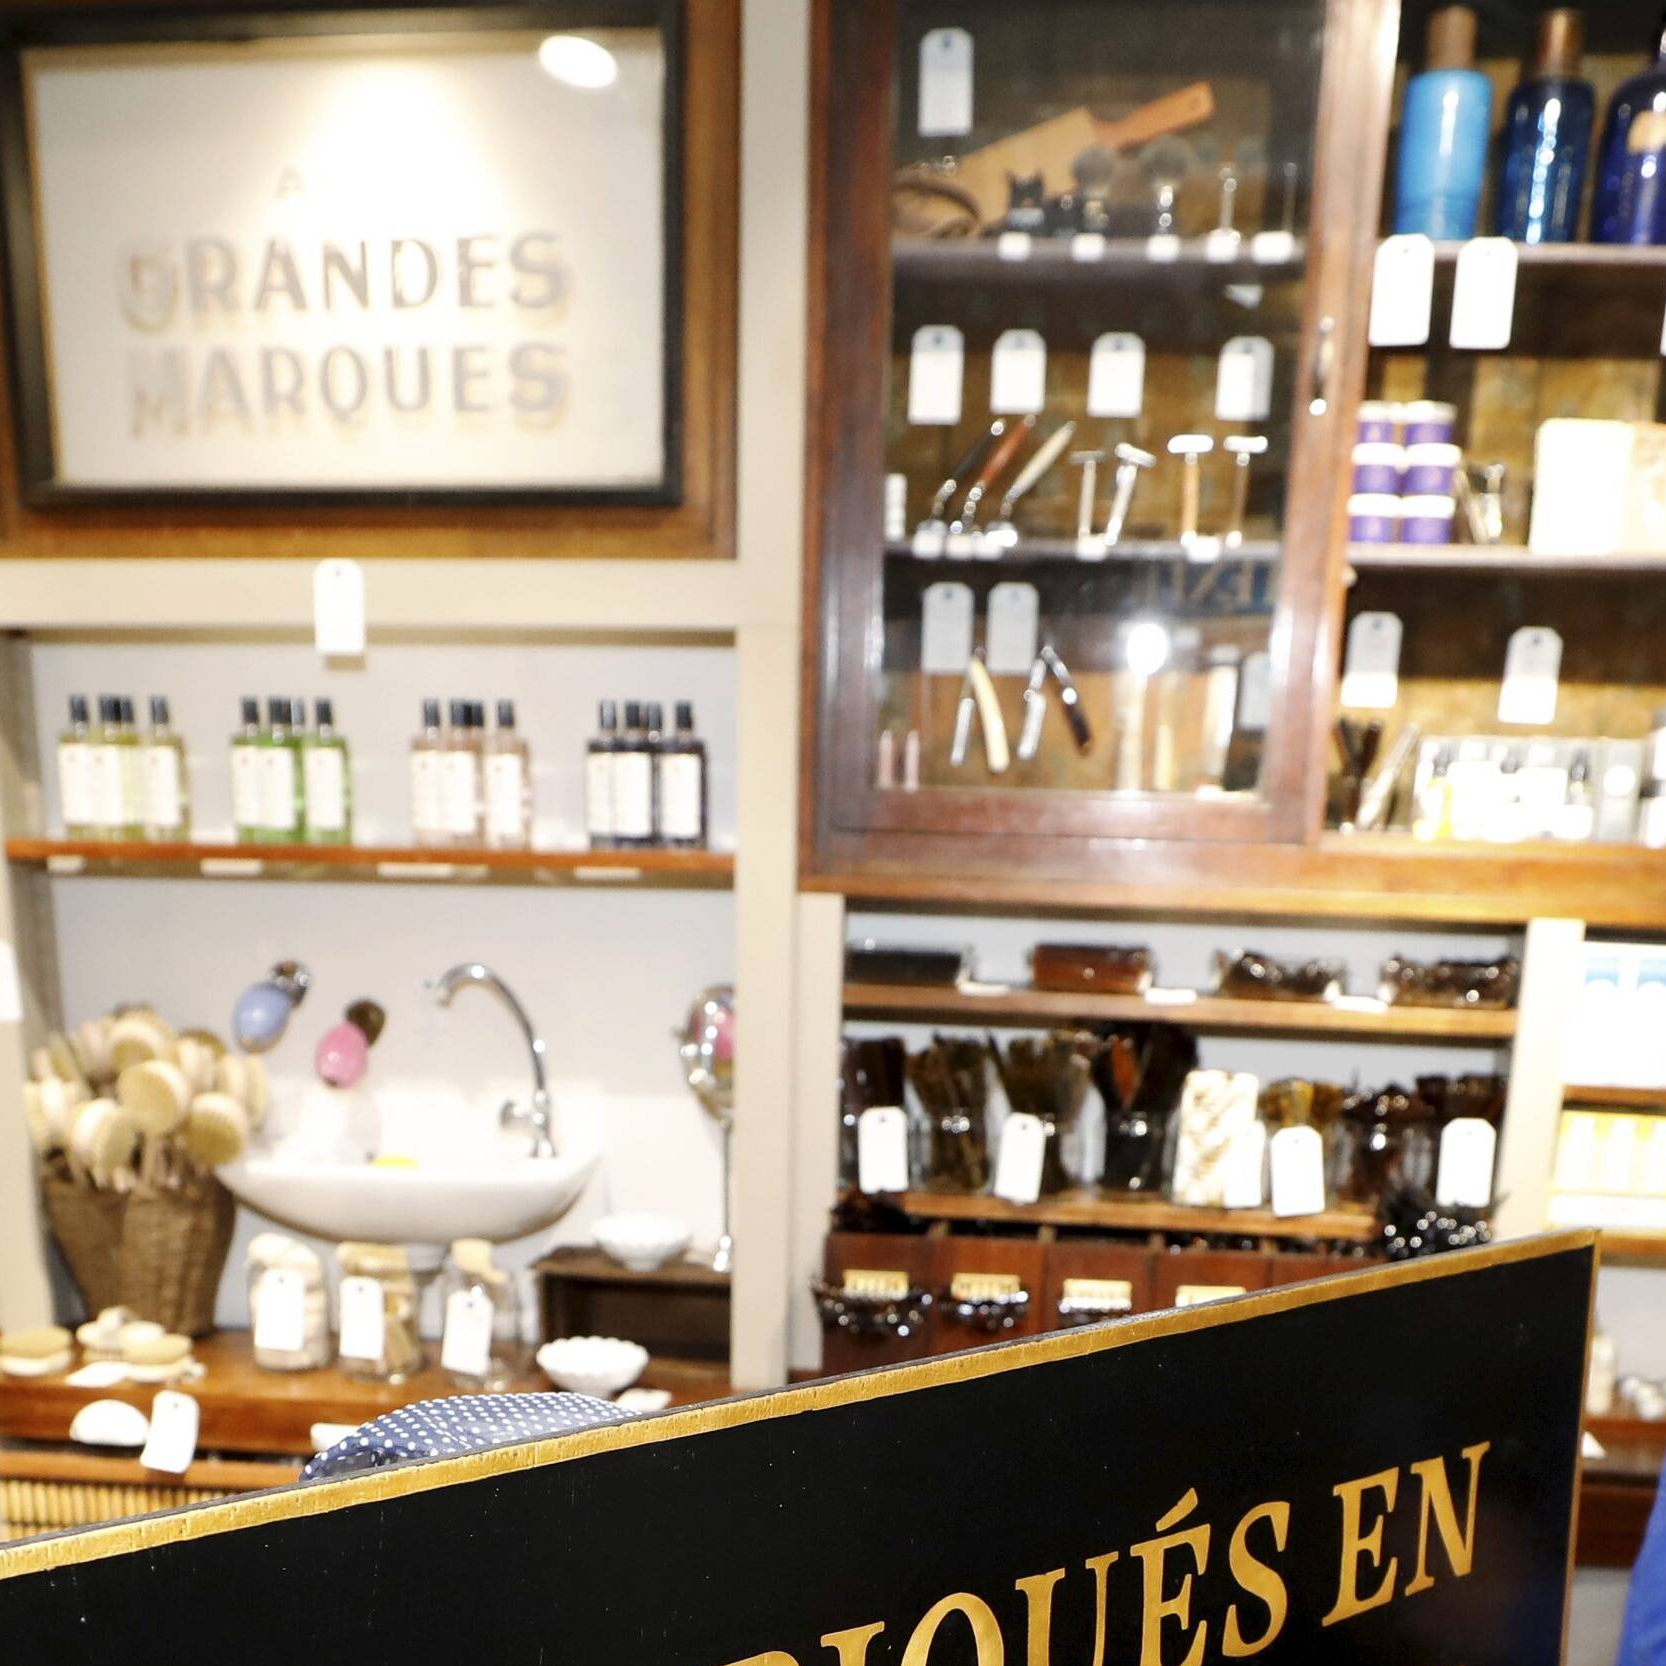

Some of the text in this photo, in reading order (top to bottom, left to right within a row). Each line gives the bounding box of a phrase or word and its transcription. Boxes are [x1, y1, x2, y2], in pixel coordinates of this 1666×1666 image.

[116, 229, 571, 335] GRANDES
[127, 340, 571, 440] MARQUES
[1322, 1441, 1490, 1626] EN
